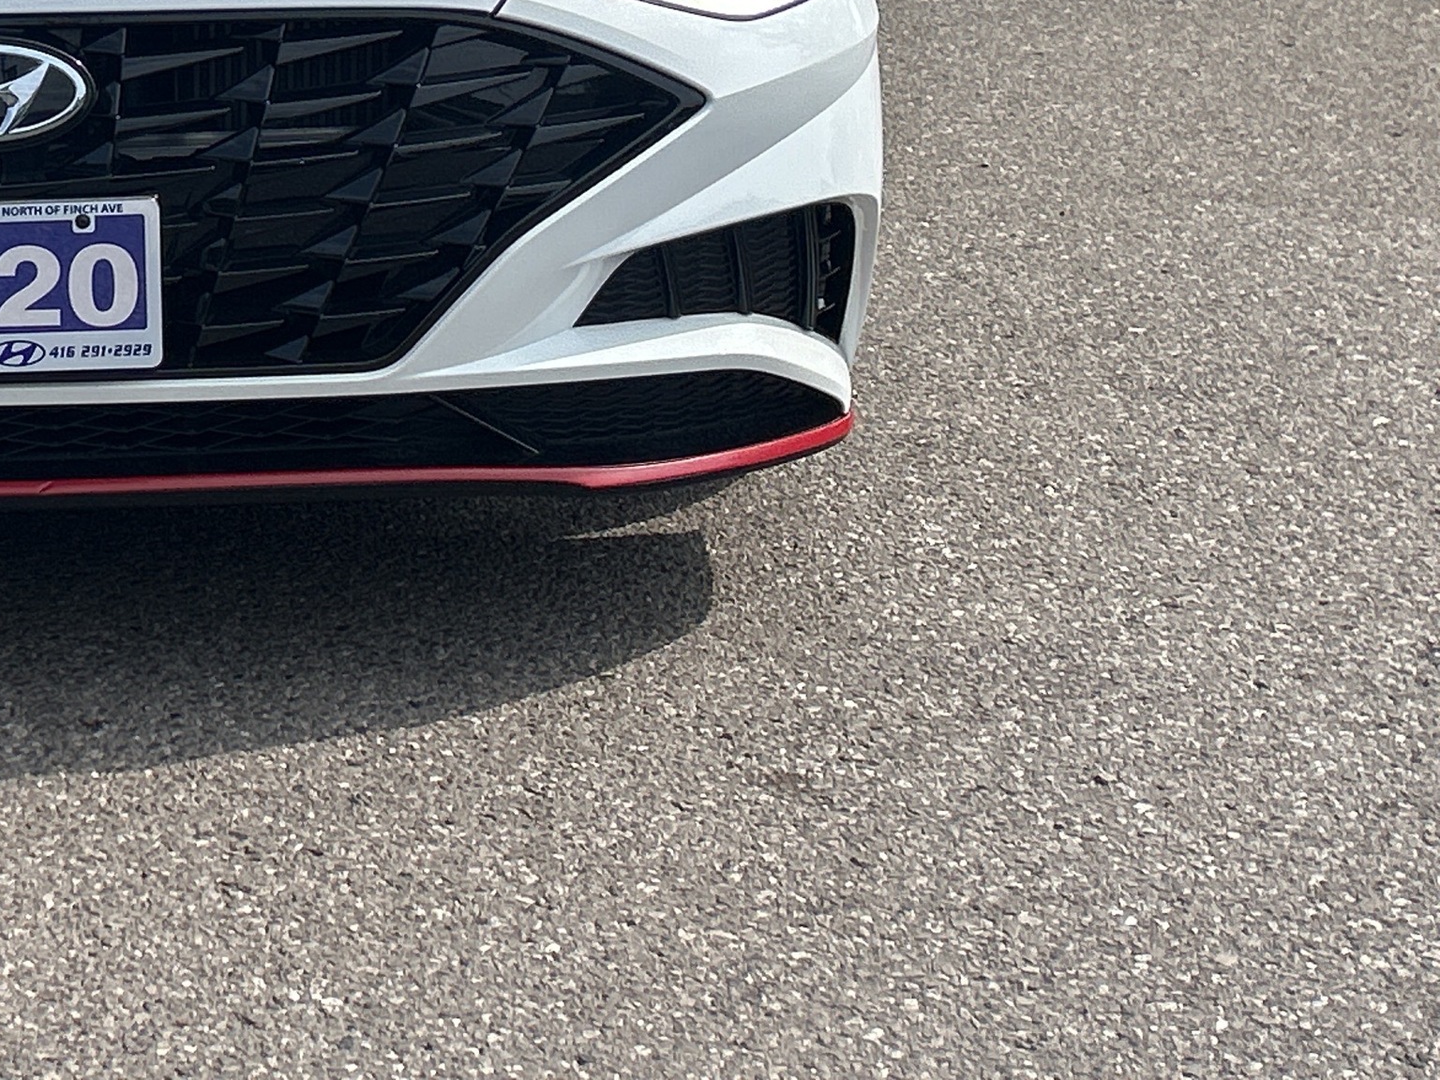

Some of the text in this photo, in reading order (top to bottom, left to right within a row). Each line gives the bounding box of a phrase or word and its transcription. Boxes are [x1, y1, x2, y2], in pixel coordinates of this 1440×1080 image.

[2, 206, 42, 217] NORTH
[45, 205, 60, 215] OF
[63, 204, 98, 215] FINCH
[100, 203, 123, 213] AVE
[49, 345, 76, 359] 416
